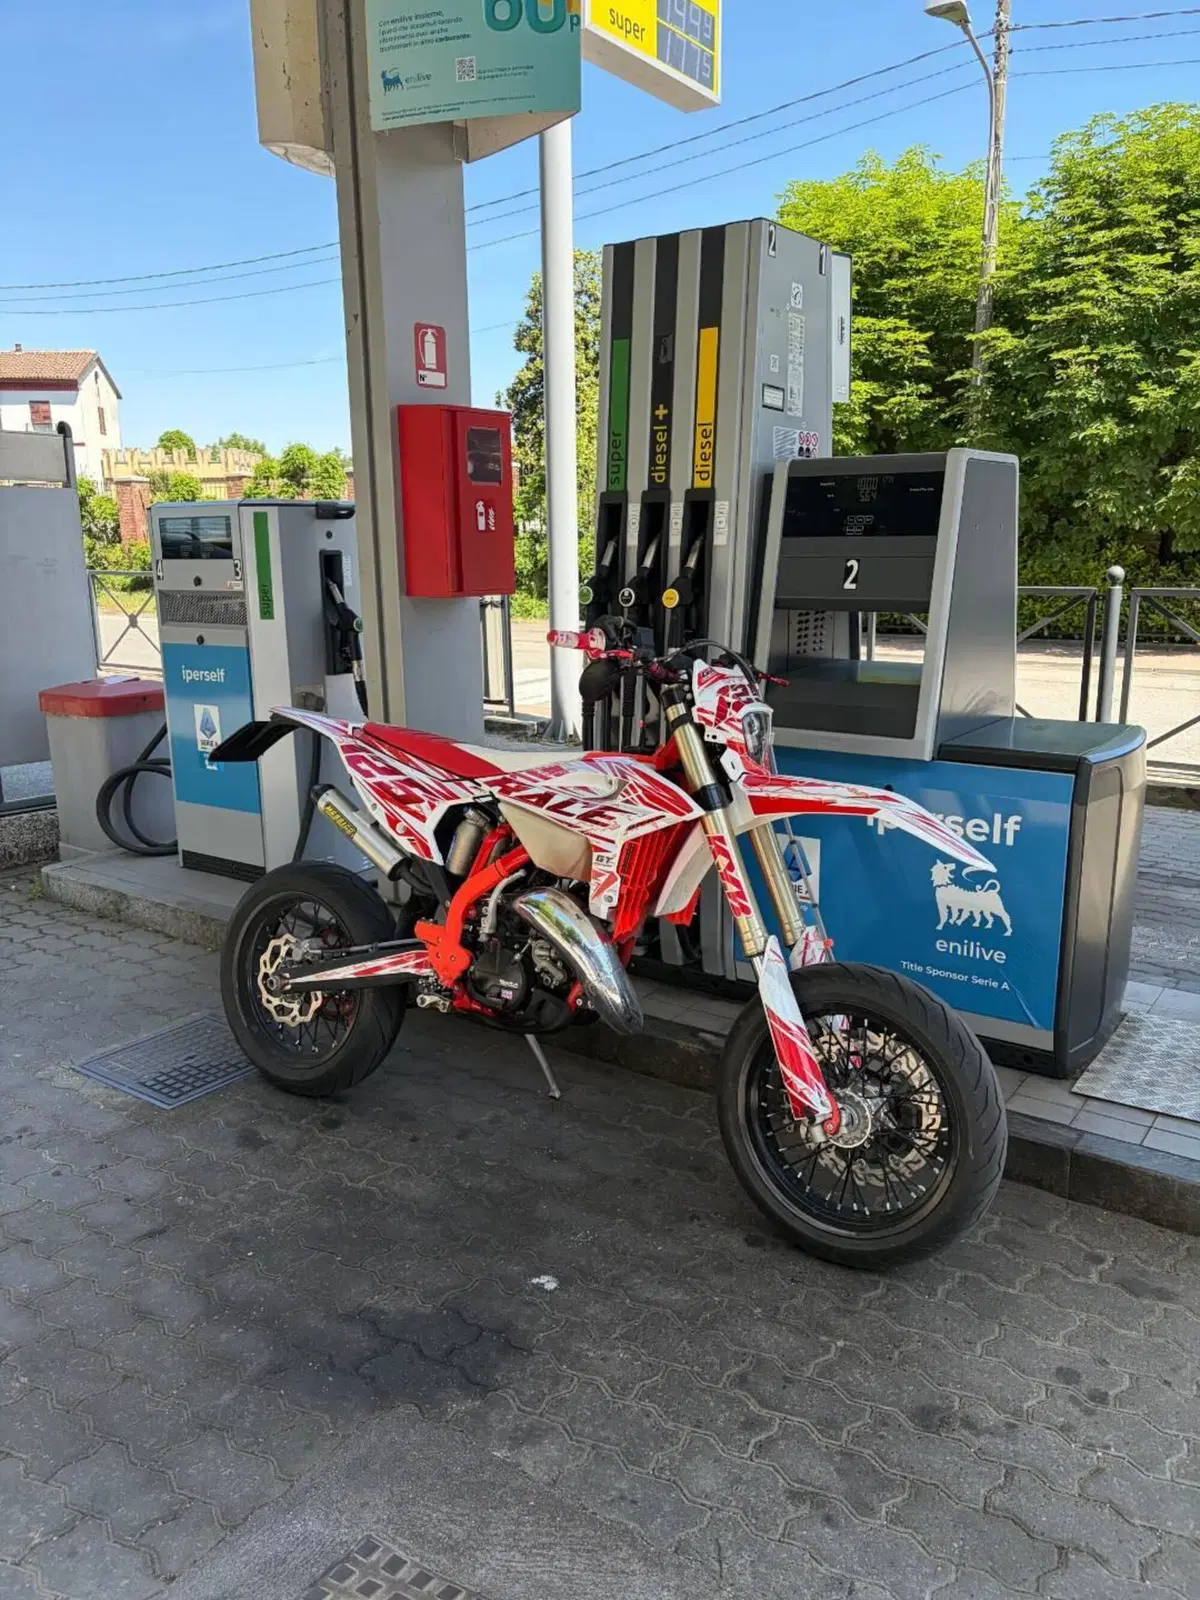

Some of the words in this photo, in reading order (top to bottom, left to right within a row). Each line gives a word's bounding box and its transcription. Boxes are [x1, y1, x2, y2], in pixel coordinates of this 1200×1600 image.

[609, 8, 646, 43] super
[768, 224, 776, 257] 2
[820, 245, 826, 275] 1
[610, 431, 624, 486] super
[651, 425, 668, 483] diesel
[695, 422, 713, 482] diesel
[157, 560, 164, 580] 4
[234, 560, 242, 580] 3
[843, 559, 859, 590] 2
[260, 584, 271, 616] super
[181, 664, 226, 684] iperself
[935, 939, 1007, 964] enilive
[900, 960, 924, 974] Title
[925, 966, 969, 983] Sponsor
[971, 975, 998, 989] Serie
[1001, 981, 1010, 992] A
